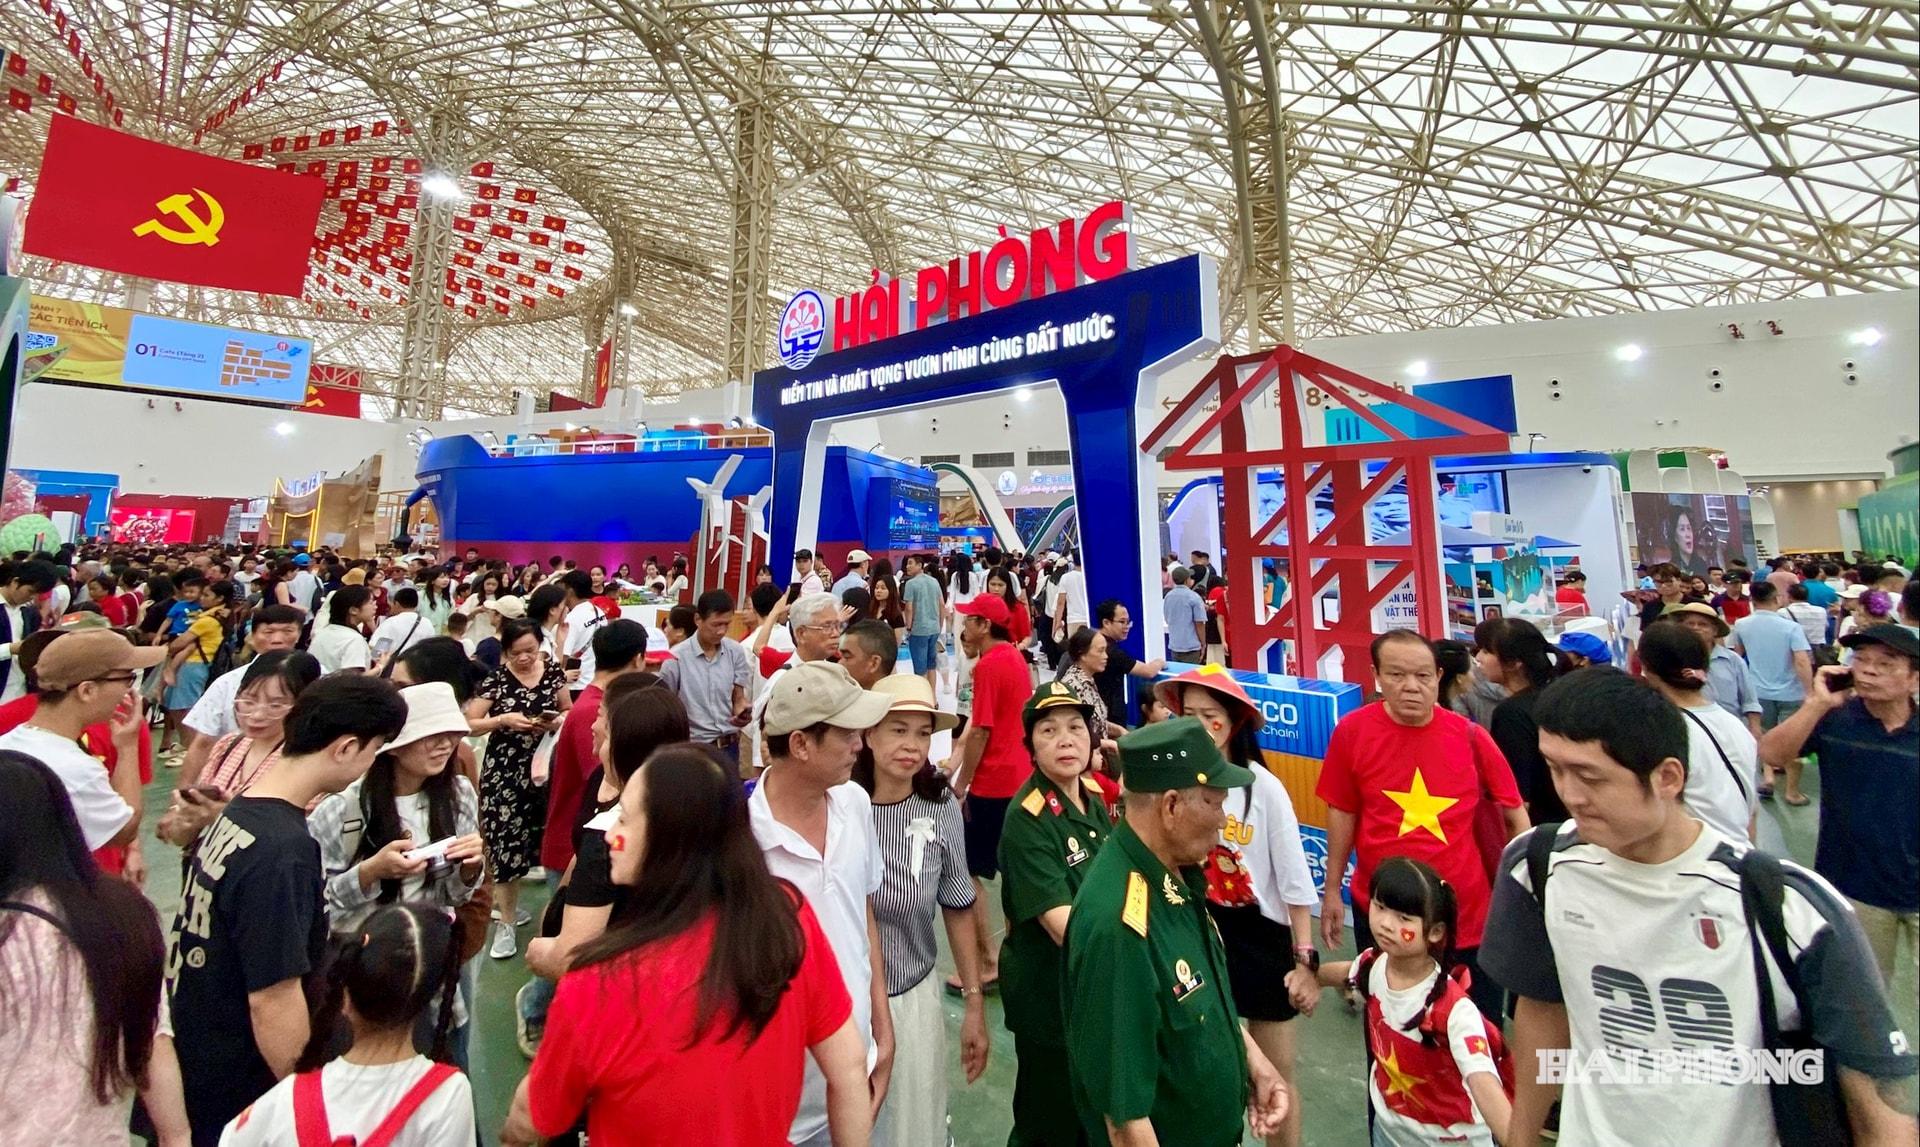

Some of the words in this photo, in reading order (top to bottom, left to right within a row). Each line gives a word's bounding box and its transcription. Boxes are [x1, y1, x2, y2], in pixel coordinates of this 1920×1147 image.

[833, 268, 899, 352] HẢI
[917, 201, 1127, 330] PHÒNG
[806, 383, 824, 400] TIN
[824, 373, 840, 396] VÀ
[840, 367, 869, 393] KHÁT
[870, 363, 904, 392] VỌNG
[905, 354, 940, 381] VƯƠN
[942, 346, 979, 373] MÌNH
[980, 336, 1024, 365] CÙNG
[1026, 321, 1060, 355] ĐẤT
[1063, 311, 1115, 348] NƯỚC
